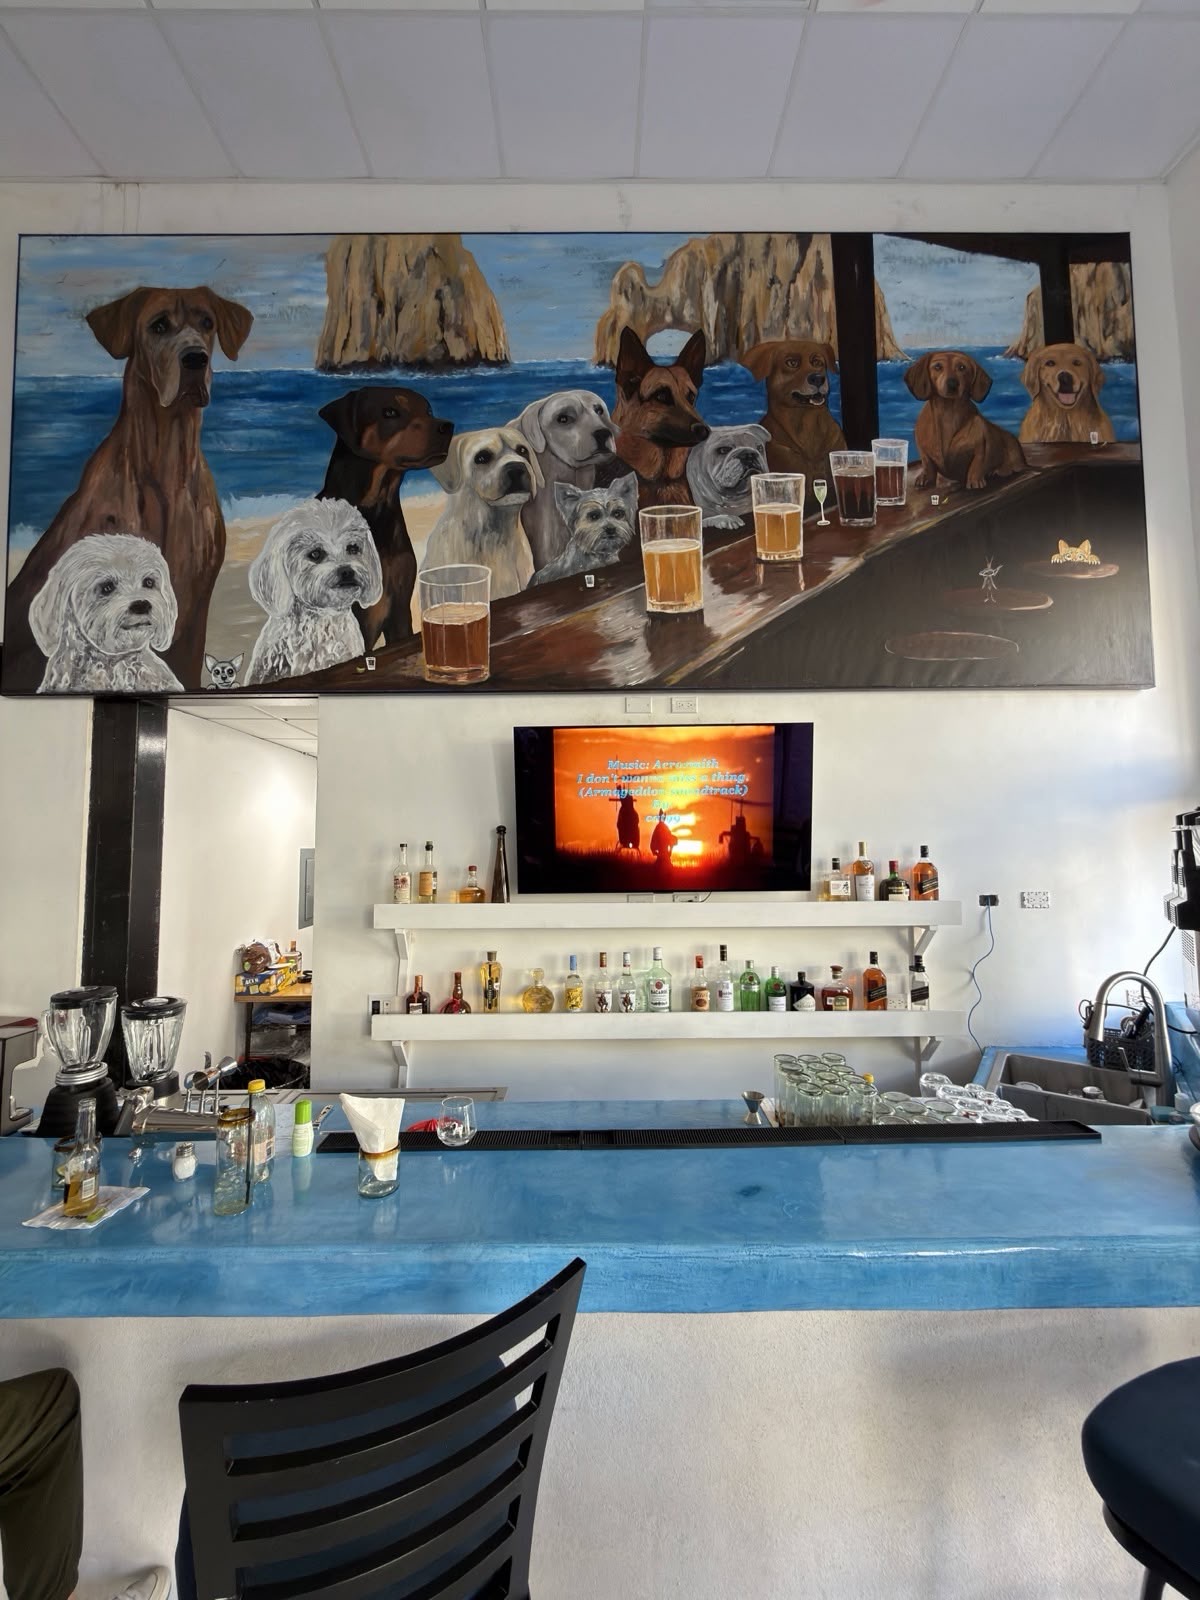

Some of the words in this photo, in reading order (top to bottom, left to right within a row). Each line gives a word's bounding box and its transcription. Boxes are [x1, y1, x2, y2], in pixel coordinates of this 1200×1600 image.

[608, 760, 649, 770] Music:
[653, 758, 719, 769] Aerosmith
[577, 774, 583, 784] I
[585, 773, 618, 784] don't
